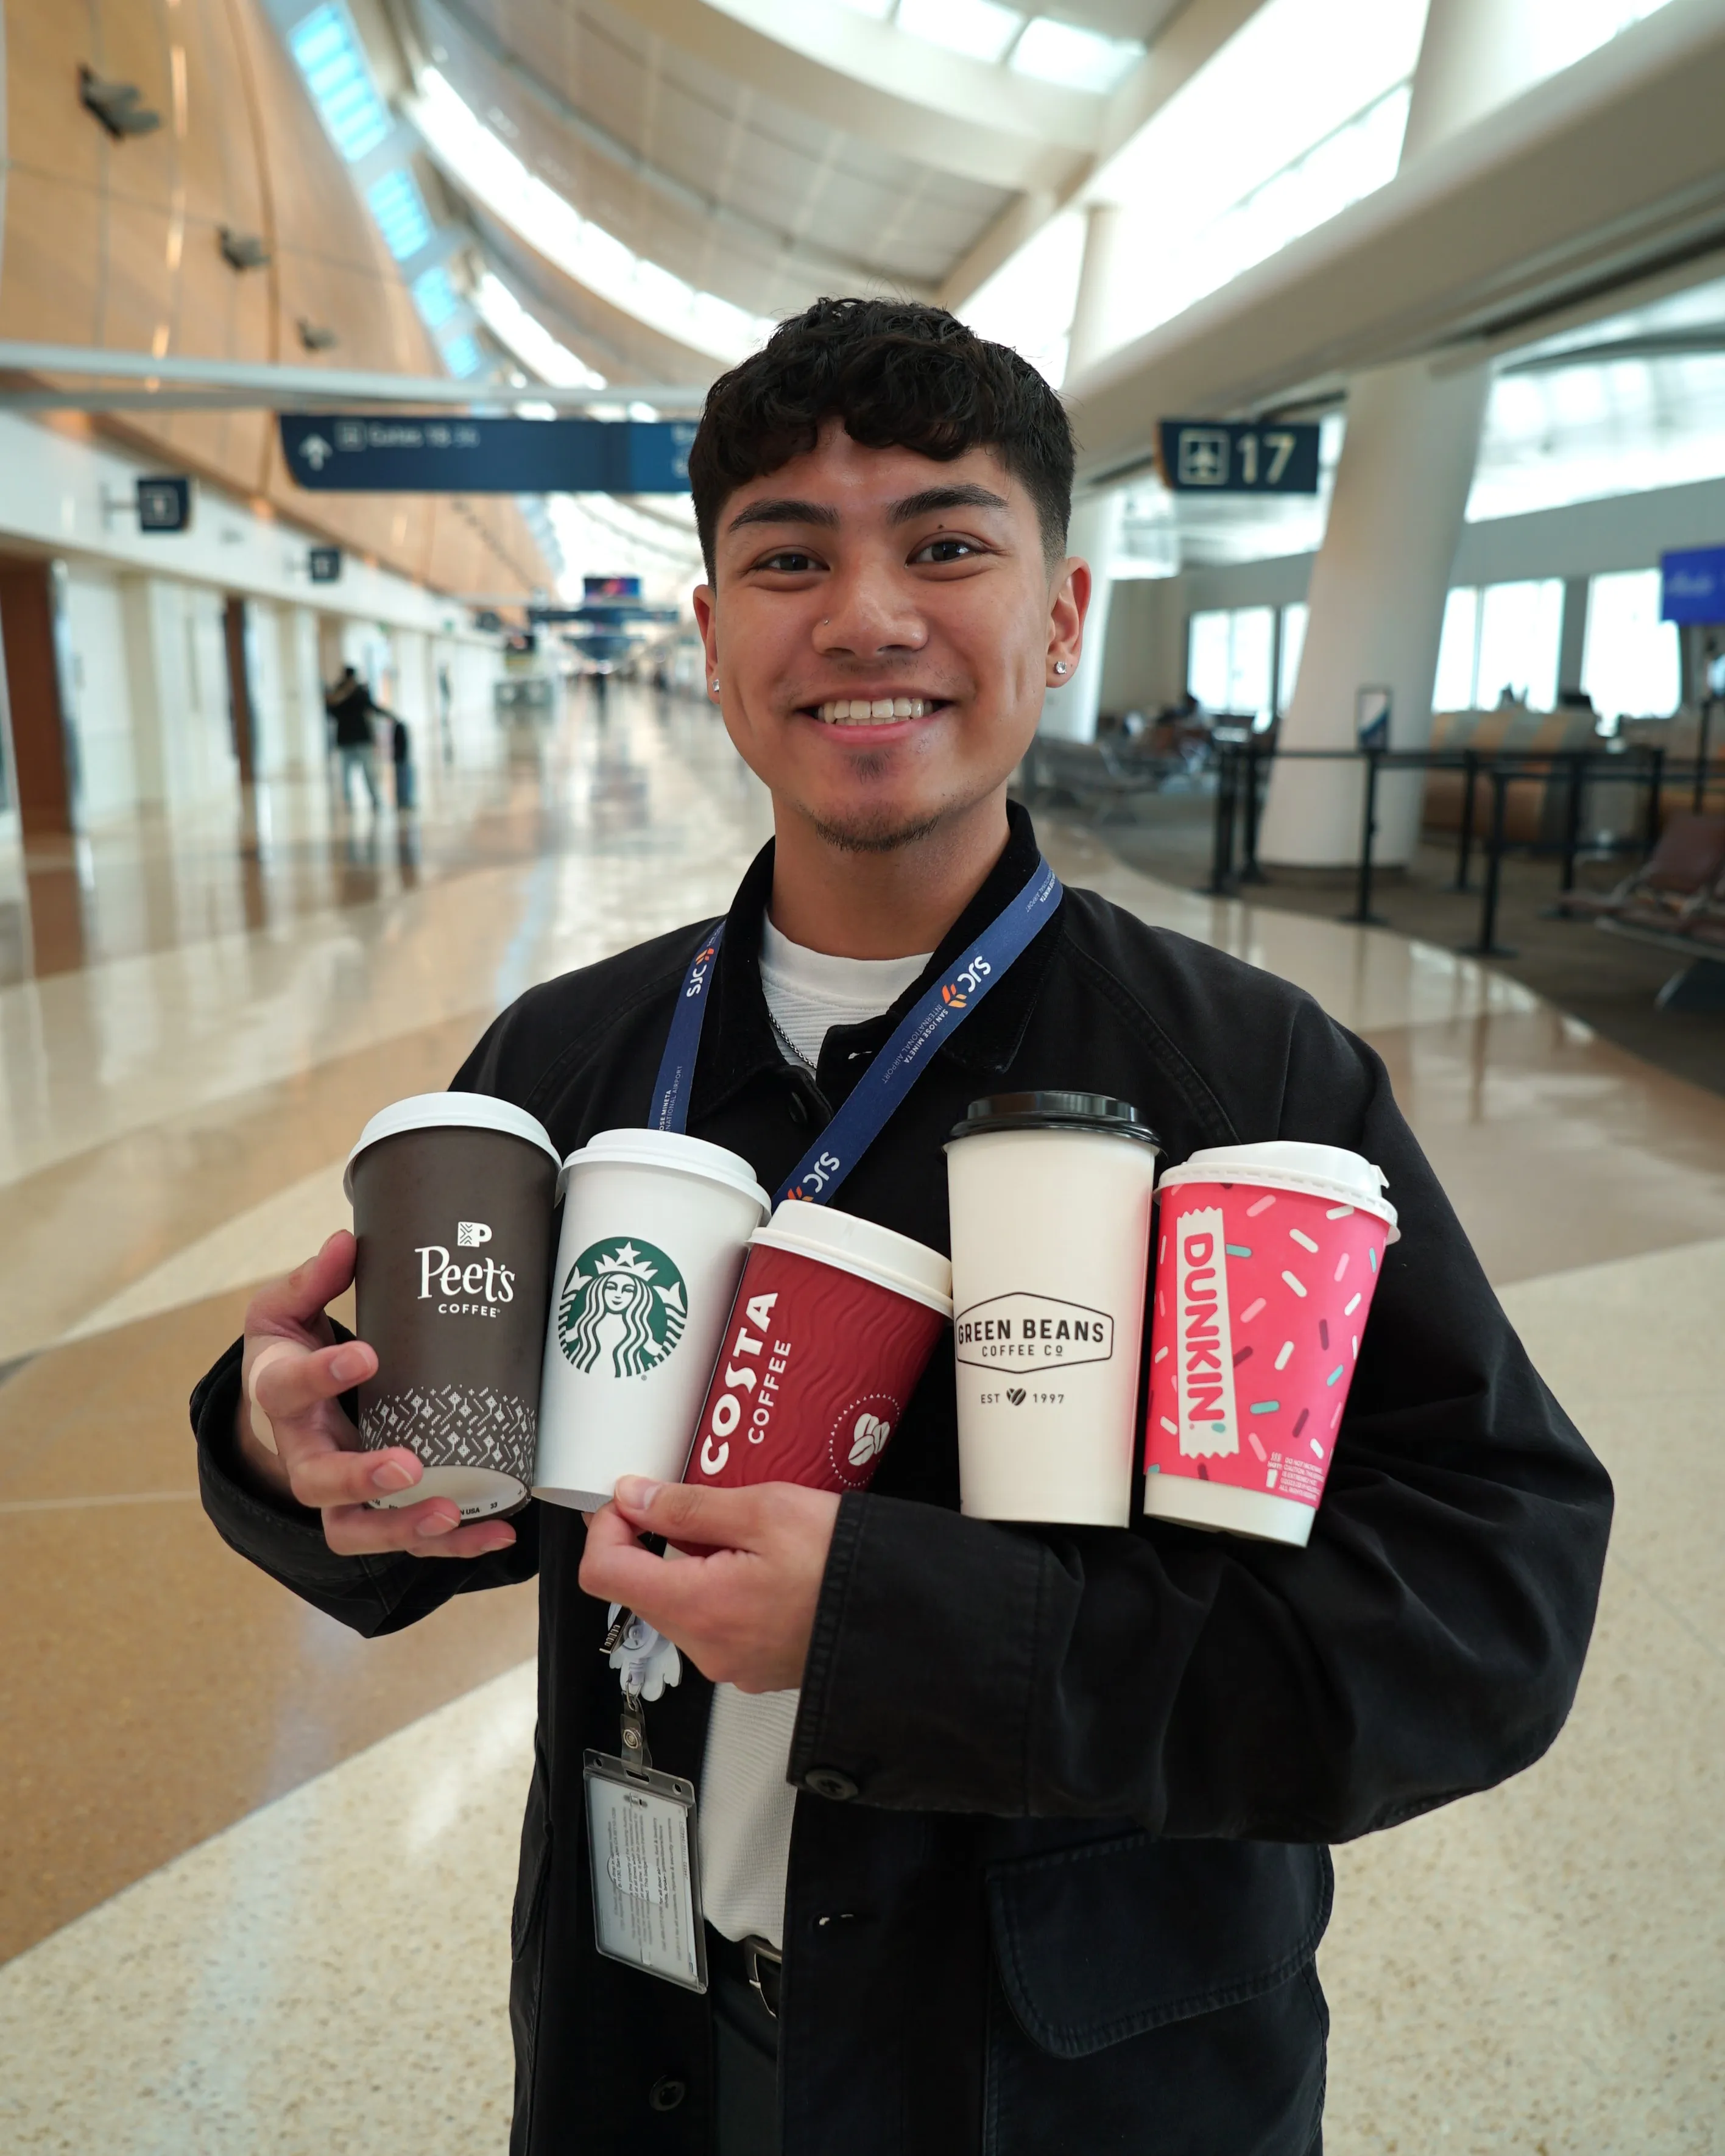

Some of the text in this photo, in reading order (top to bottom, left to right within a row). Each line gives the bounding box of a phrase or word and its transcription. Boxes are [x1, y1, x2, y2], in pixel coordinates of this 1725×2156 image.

[1236, 432, 1296, 485] 17
[686, 964, 707, 998] SJC
[957, 956, 991, 992] SJC
[881, 1004, 943, 1083] INTERNATIONAL AIRPORT
[903, 1009, 948, 1063] SAN JOSE MINETA
[661, 1090, 671, 1115] MINETA
[666, 1066, 682, 1132] NATIONAL AIRPORT
[802, 1151, 840, 1193] SJC
[414, 1245, 515, 1302] Peet's
[438, 1303, 496, 1318] COFFEE
[958, 1319, 1104, 1344] GREEN BEANS
[982, 1344, 1034, 1357] COFFEE
[700, 1292, 778, 1475] COSTA
[748, 1340, 791, 1444] COFFEE
[981, 1393, 1064, 1404] EST 1997
